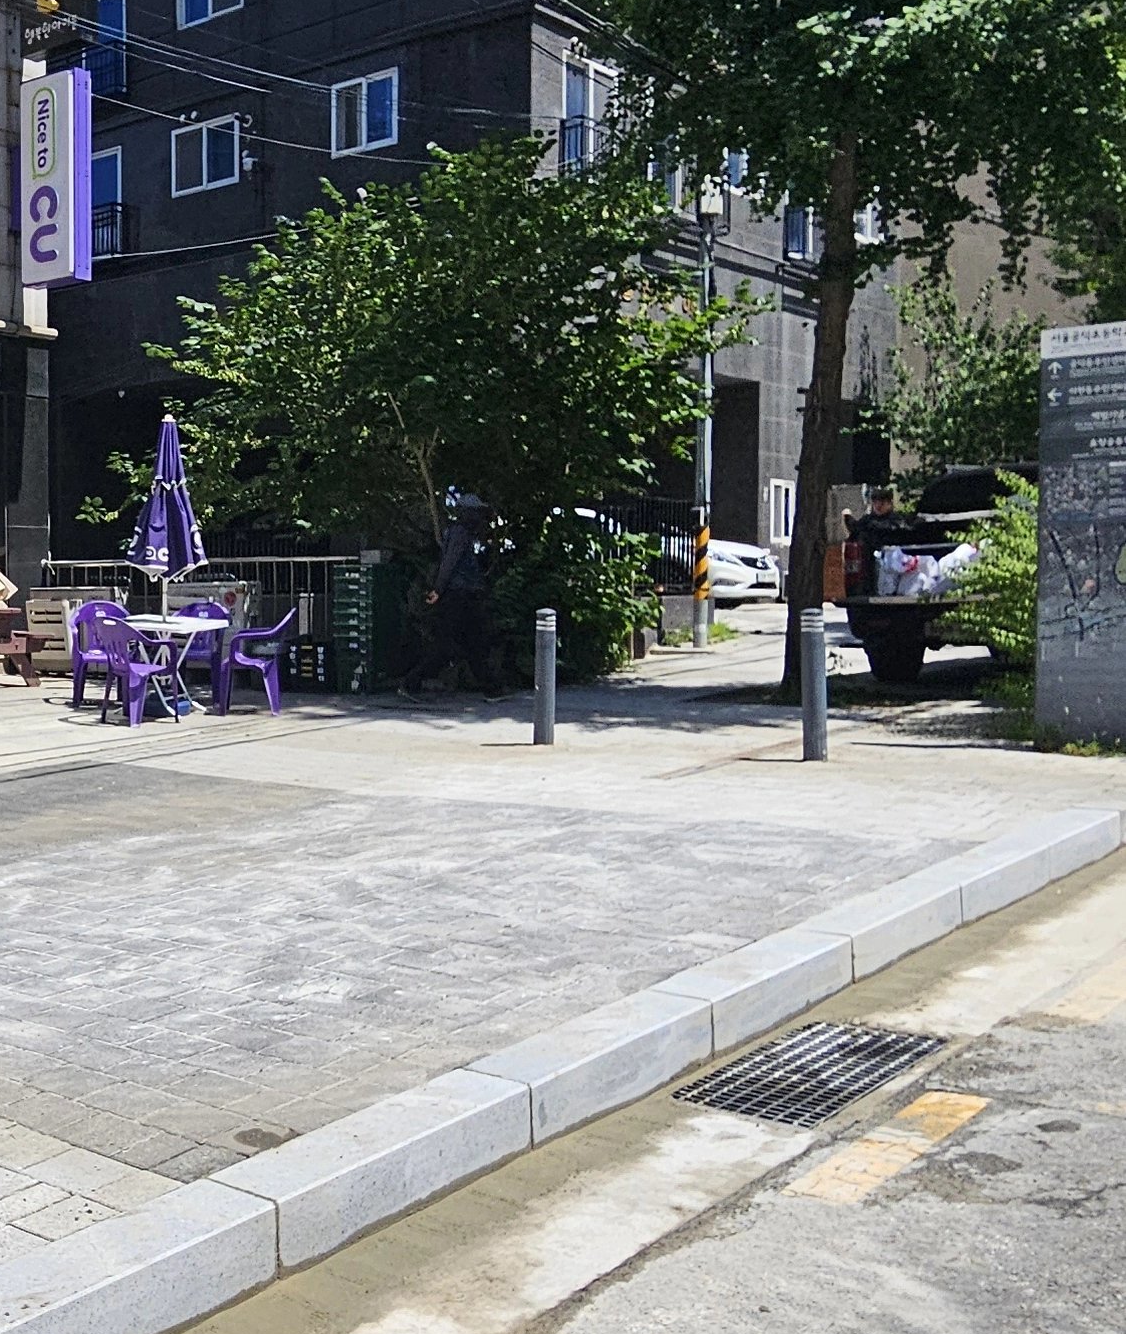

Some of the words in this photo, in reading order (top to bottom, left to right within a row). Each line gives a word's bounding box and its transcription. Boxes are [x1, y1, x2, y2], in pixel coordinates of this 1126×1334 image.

[37, 98, 49, 144] Nice
[37, 149, 49, 169] to
[30, 185, 58, 263] CU
